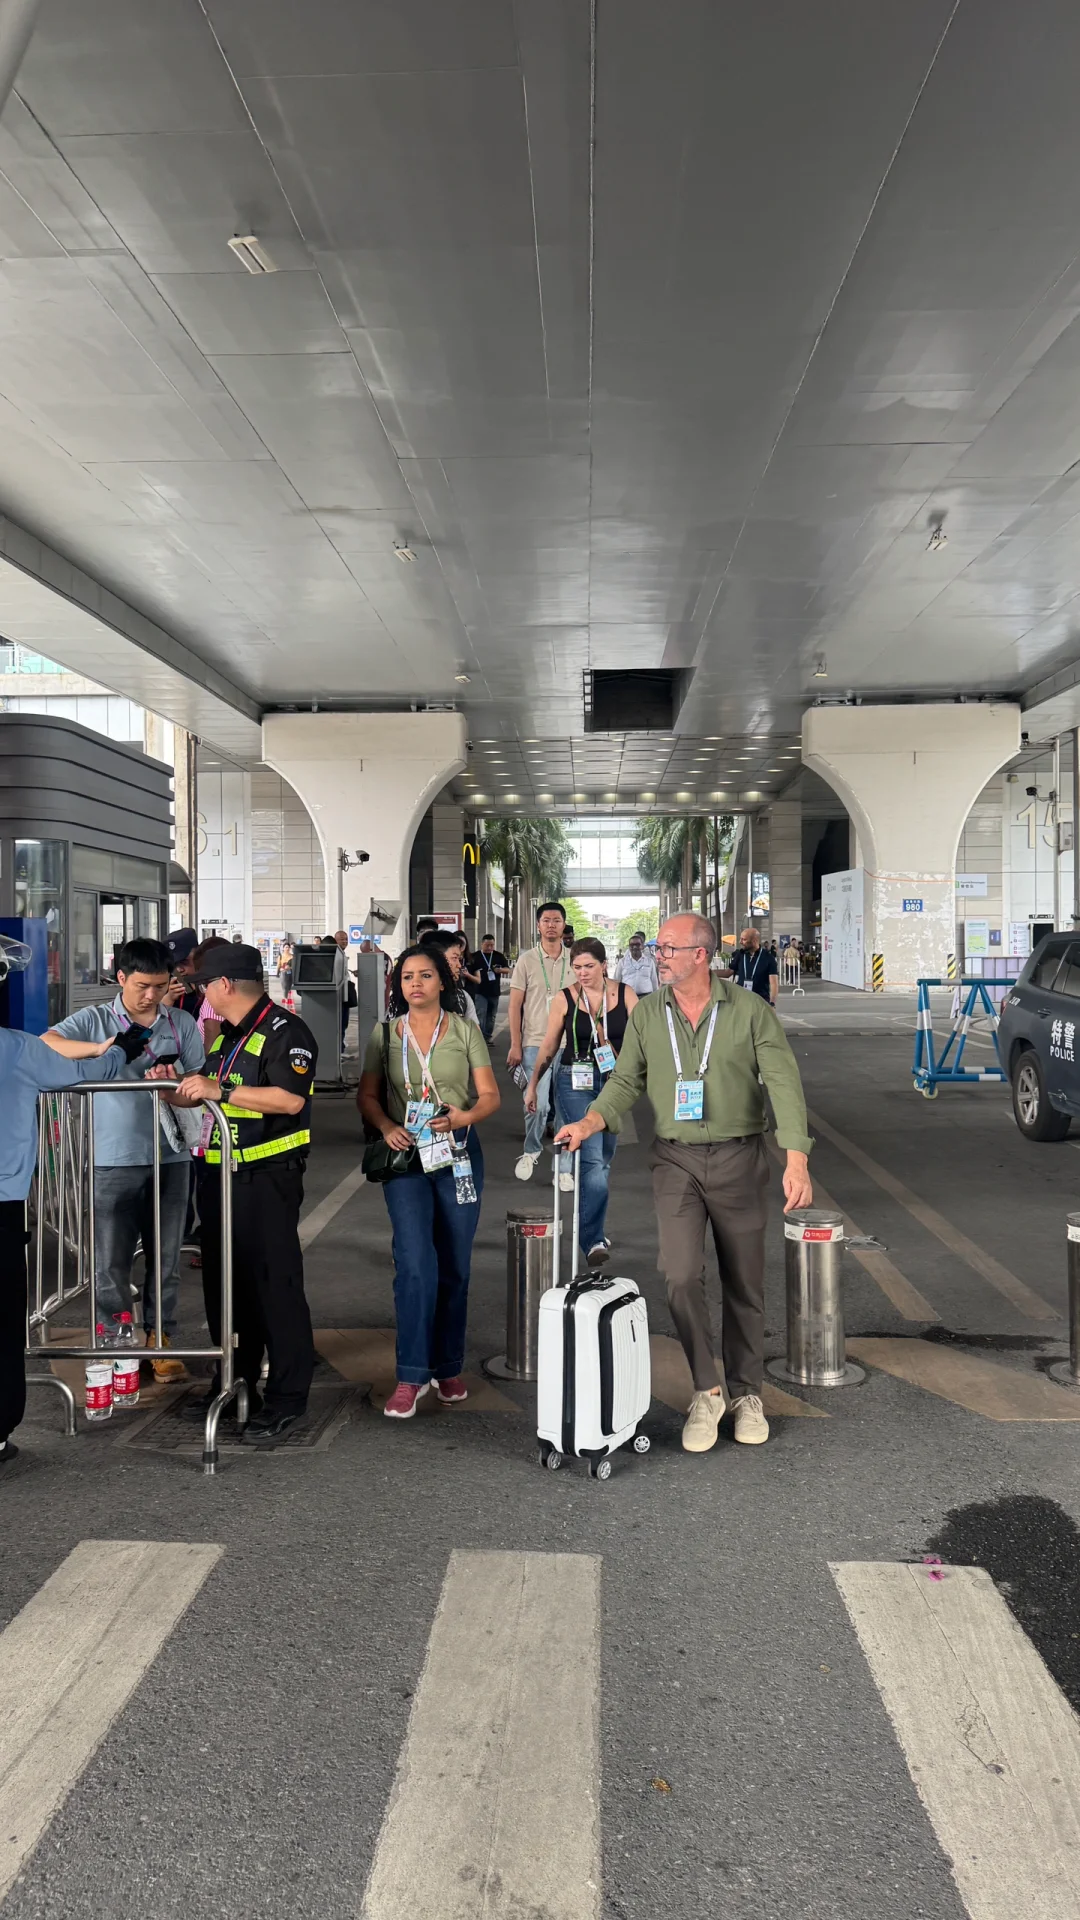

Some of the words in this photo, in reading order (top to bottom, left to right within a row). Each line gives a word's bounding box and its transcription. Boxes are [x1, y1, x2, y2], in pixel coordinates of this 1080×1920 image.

[905, 903, 921, 911] 980
[1051, 1019, 1076, 1050] 特警
[1050, 1045, 1075, 1062] POLICE
